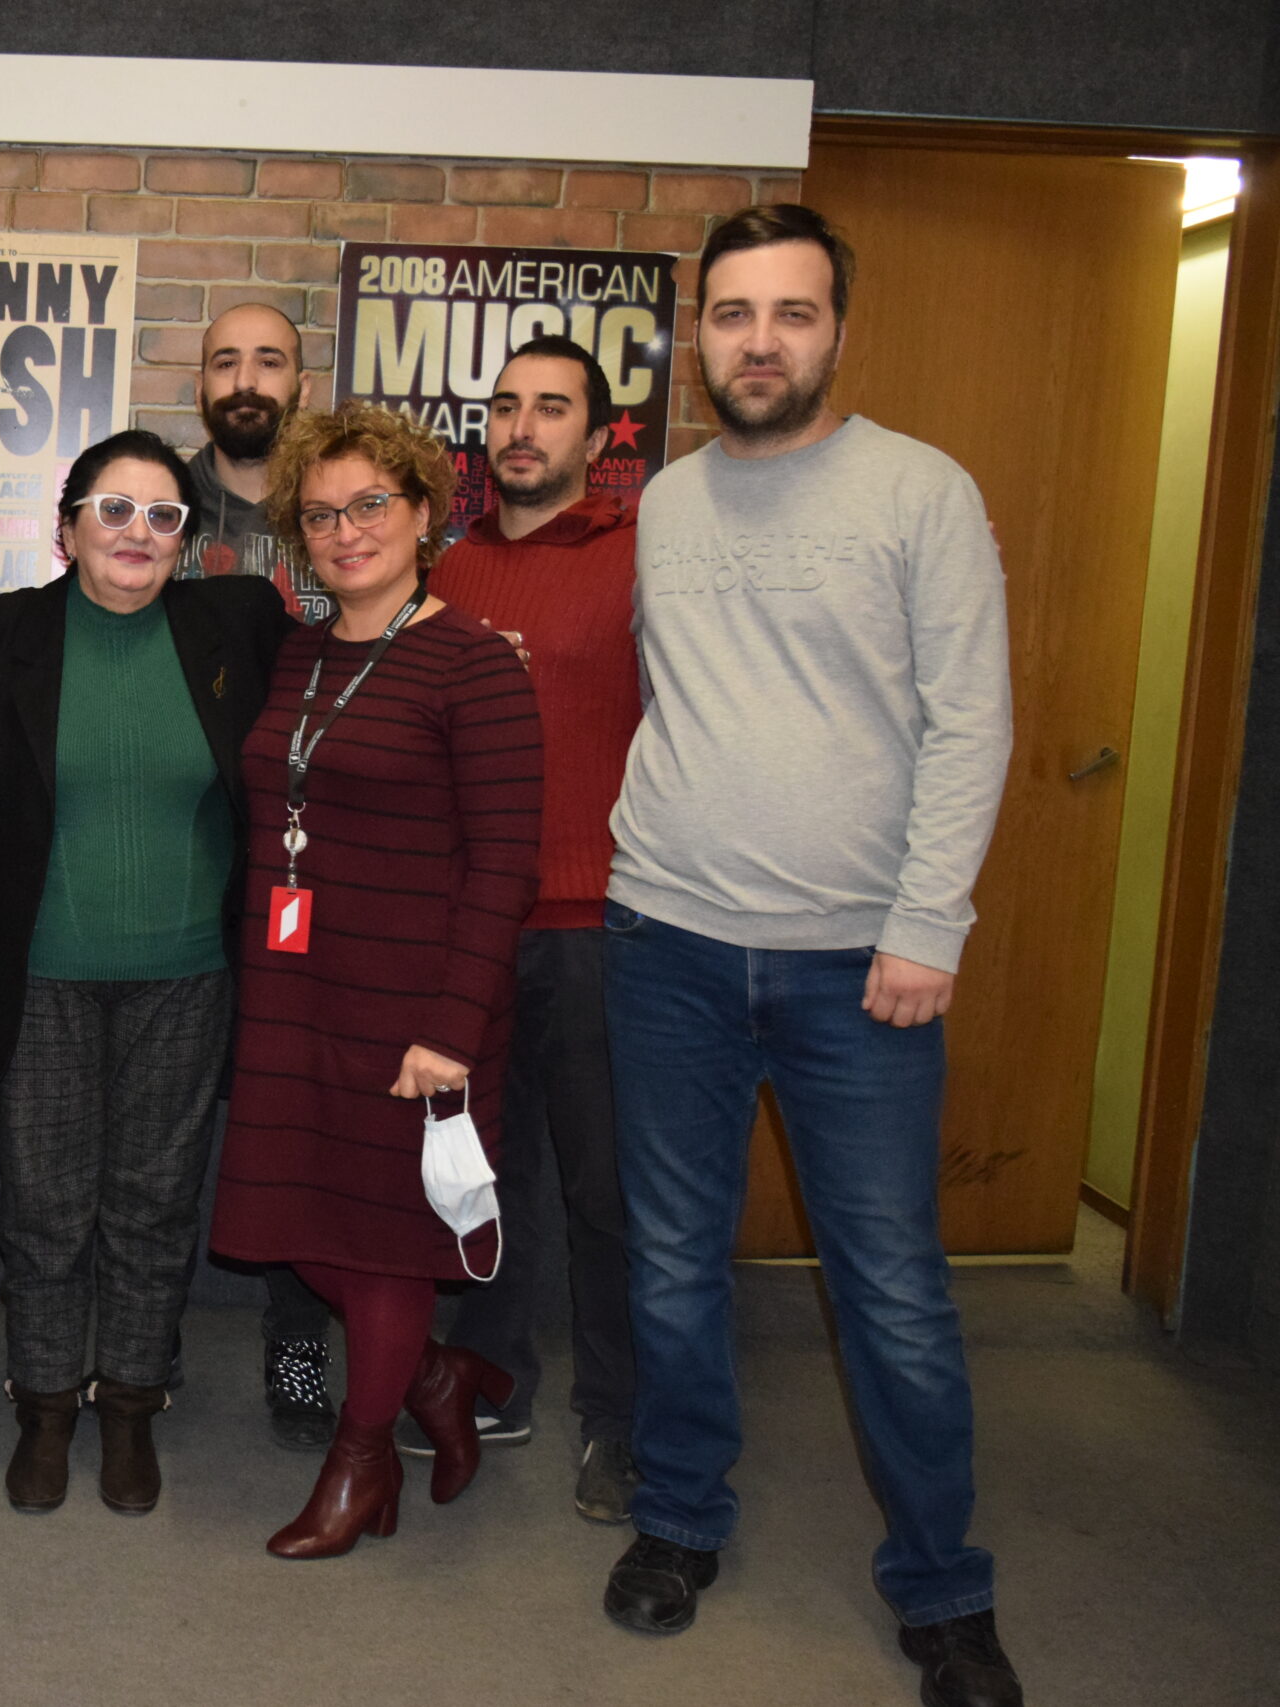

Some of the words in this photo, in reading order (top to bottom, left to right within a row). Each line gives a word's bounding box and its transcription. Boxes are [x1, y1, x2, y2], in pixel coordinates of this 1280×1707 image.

[358, 255, 447, 296] 2008
[447, 259, 660, 303] AMERICAN
[589, 471, 645, 486] WEST
